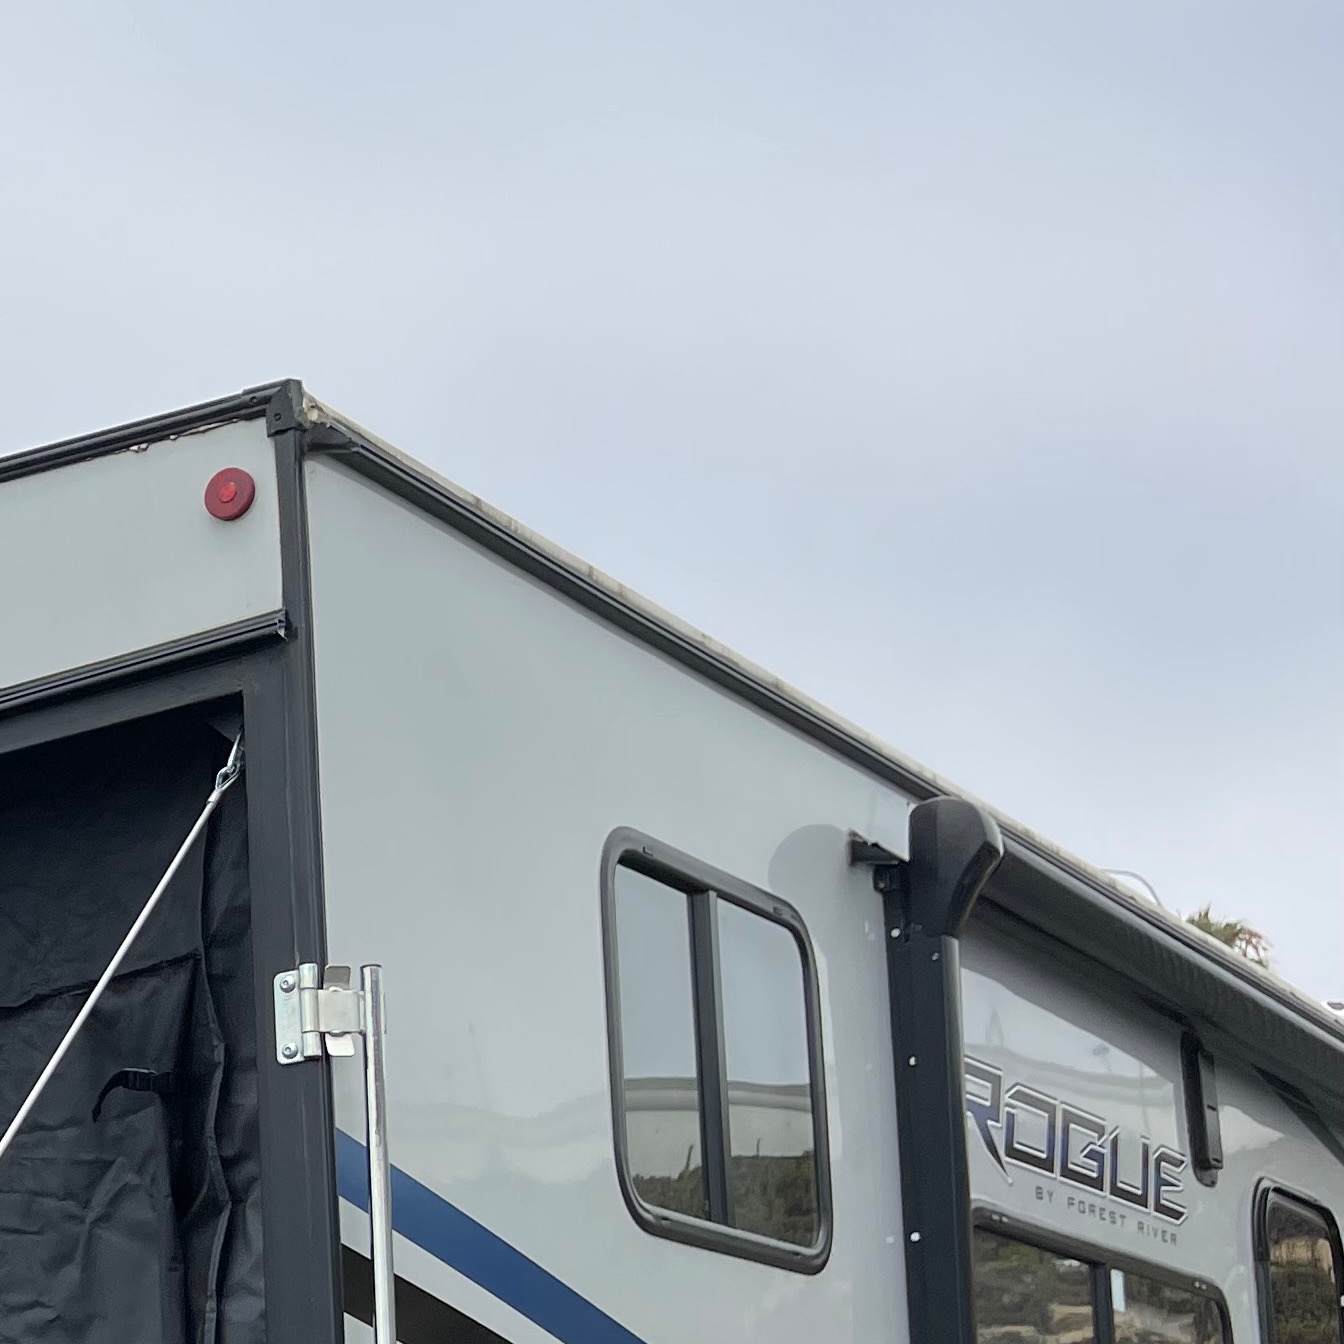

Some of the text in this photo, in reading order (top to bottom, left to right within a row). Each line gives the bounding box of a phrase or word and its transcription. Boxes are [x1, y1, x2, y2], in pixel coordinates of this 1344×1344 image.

[964, 1054, 1189, 1225] ROGUE
[1035, 1186, 1178, 1245] BY FOREST RIVER
